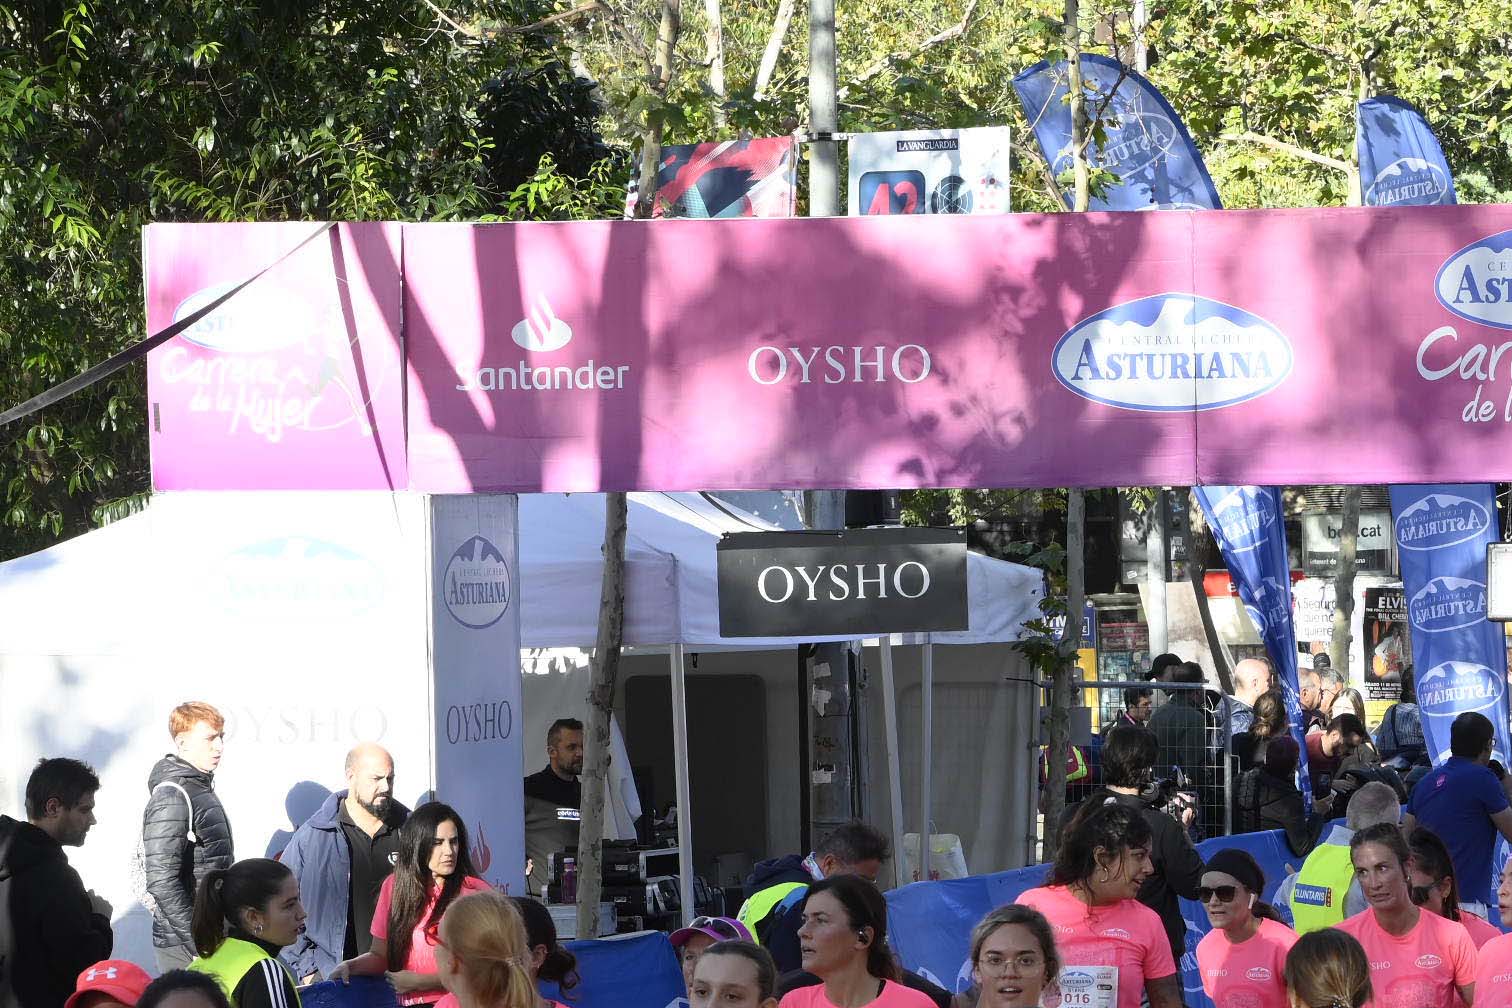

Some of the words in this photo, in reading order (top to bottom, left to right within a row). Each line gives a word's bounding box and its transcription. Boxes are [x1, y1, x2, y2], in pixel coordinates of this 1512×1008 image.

[455, 359, 629, 390] Santander
[748, 344, 931, 385] OYSHO
[1072, 338, 1273, 382] ASTURIANA
[1461, 384, 1497, 424] de
[449, 576, 508, 608] ASTURIANA
[757, 561, 931, 603] OYSHO
[446, 700, 511, 745] OYSHO
[1064, 993, 1090, 1004] 016
